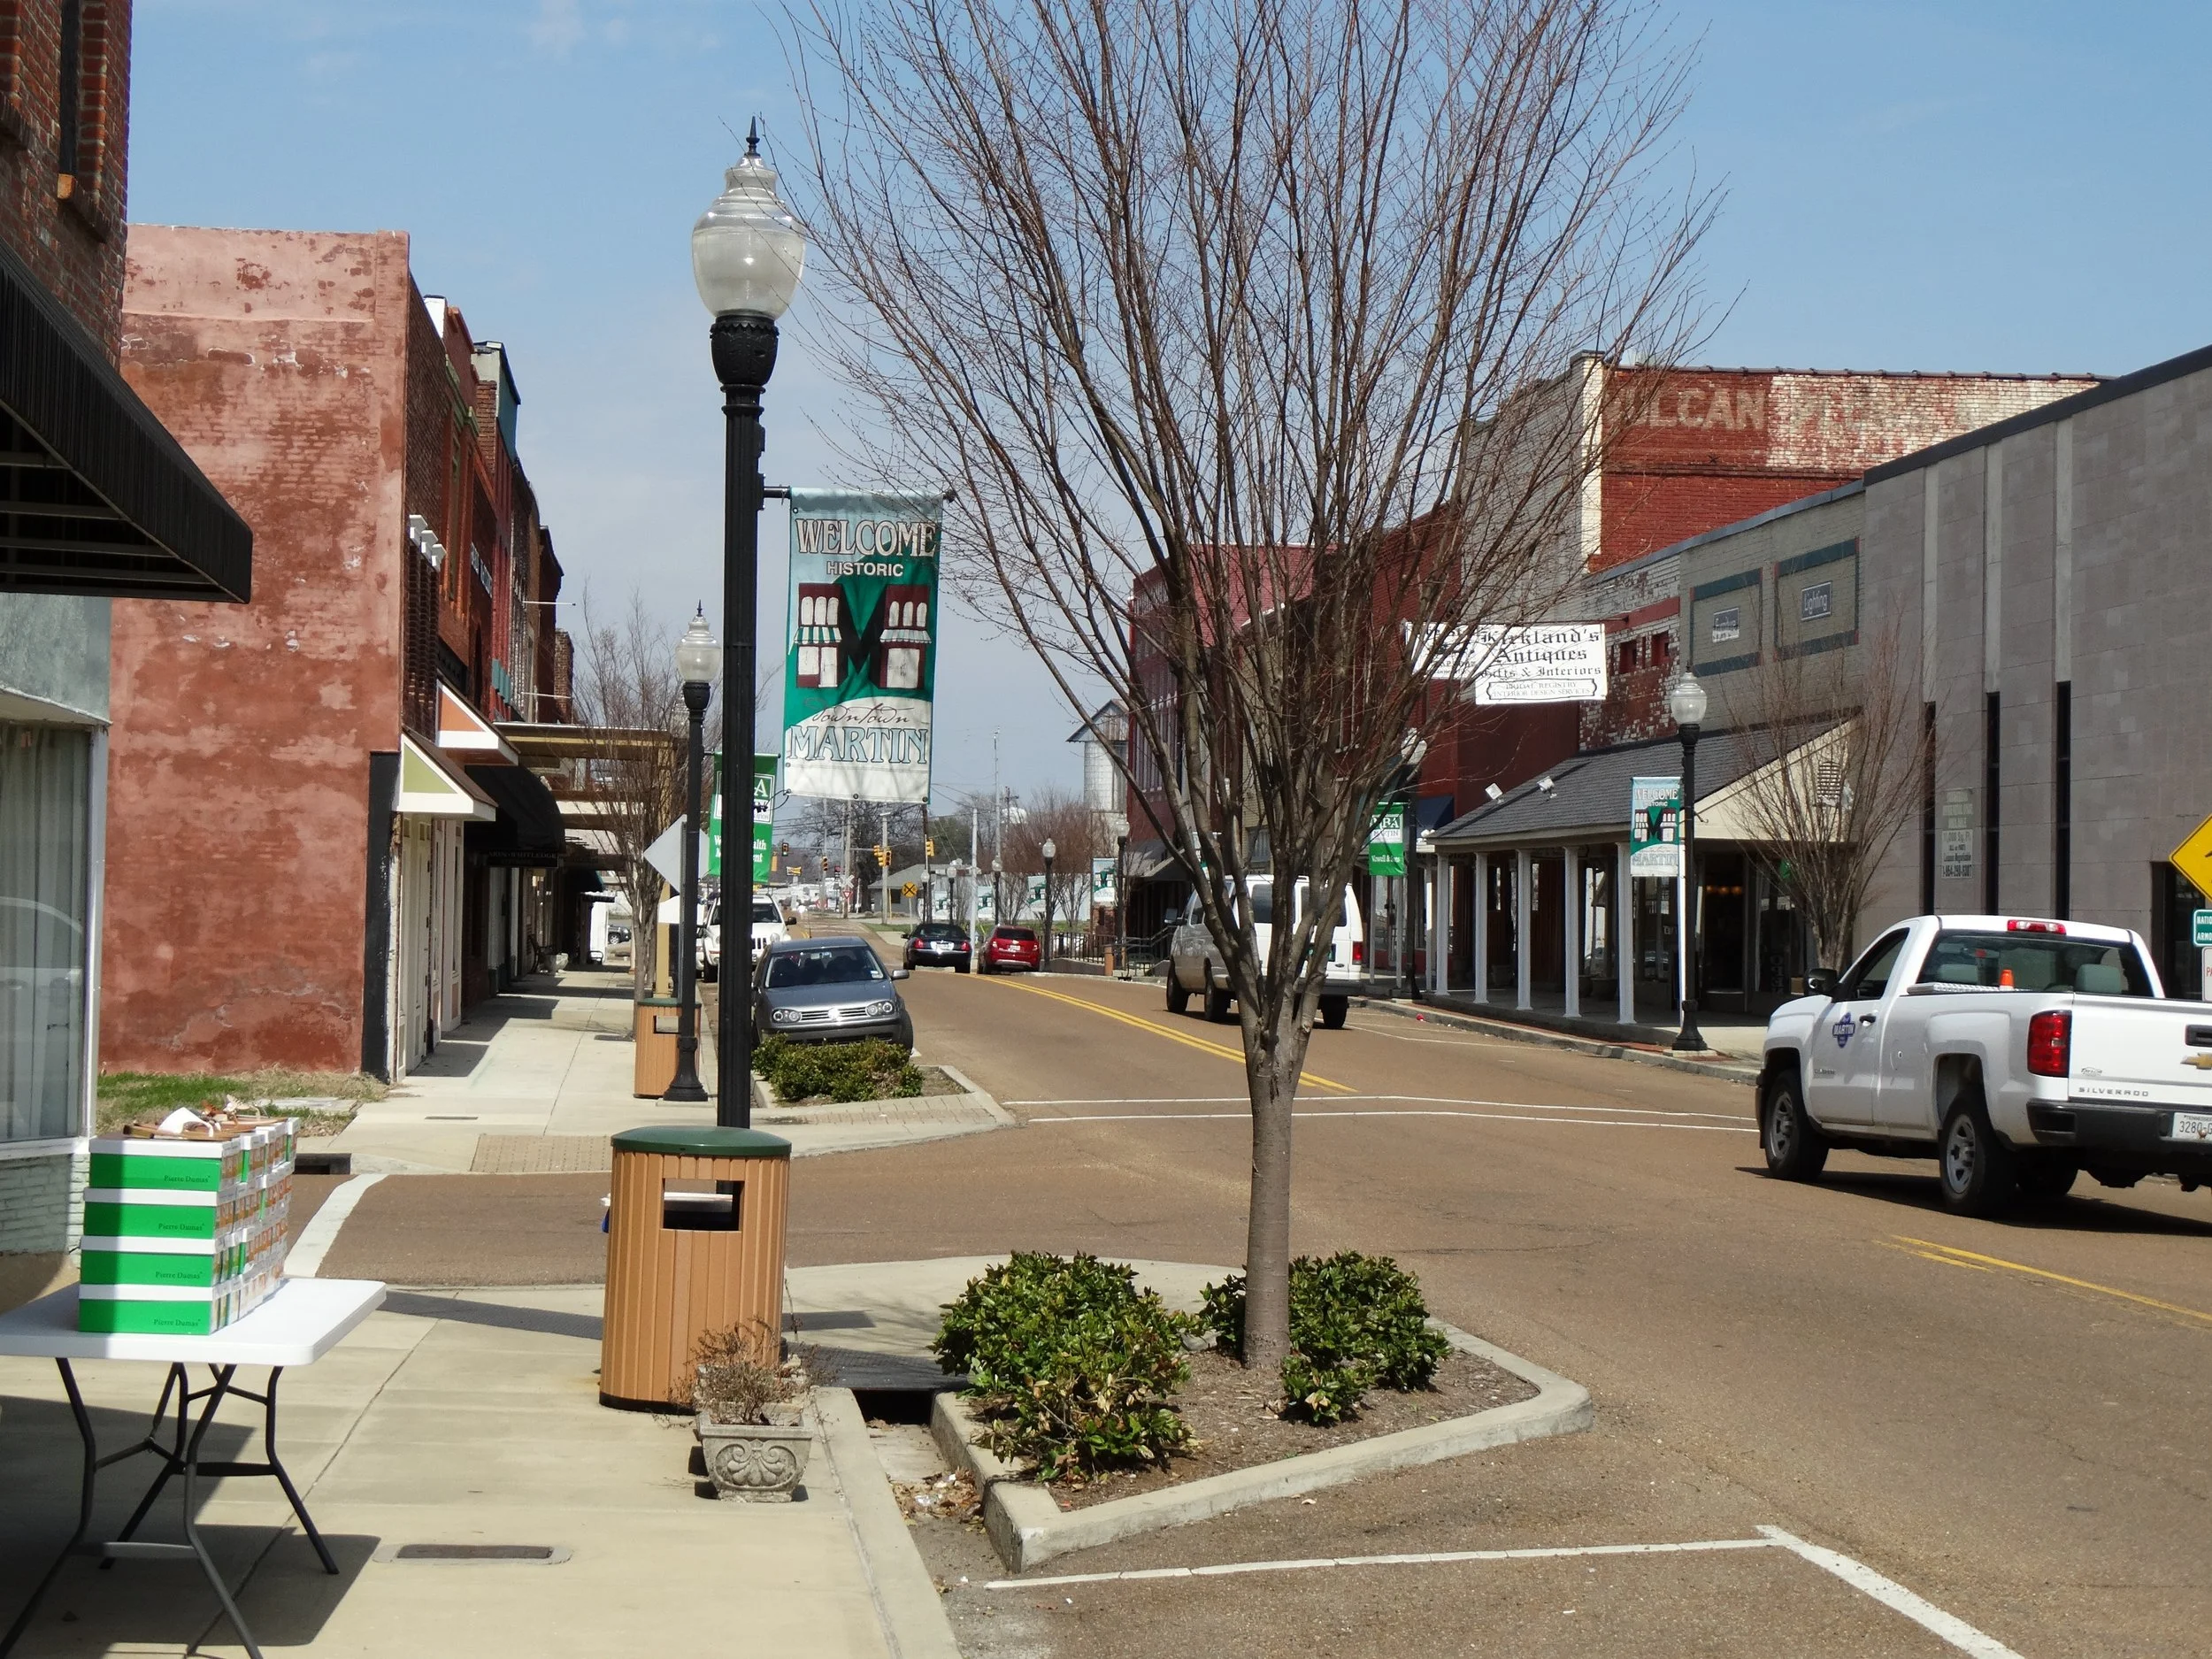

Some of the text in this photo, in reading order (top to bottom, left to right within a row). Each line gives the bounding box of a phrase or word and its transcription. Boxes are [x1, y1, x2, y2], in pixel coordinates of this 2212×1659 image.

[795, 518, 936, 557] WELCOME
[826, 560, 904, 577] HISTORIC
[1804, 590, 1828, 615] Lighting
[1494, 647, 1587, 664] Antiques
[1538, 665, 1601, 677] Interiors
[787, 726, 928, 764] MARTIN
[1633, 788, 1678, 800] WELCOME
[1632, 854, 1678, 865] MARTIN
[2078, 1087, 2149, 1097] SILVERADO
